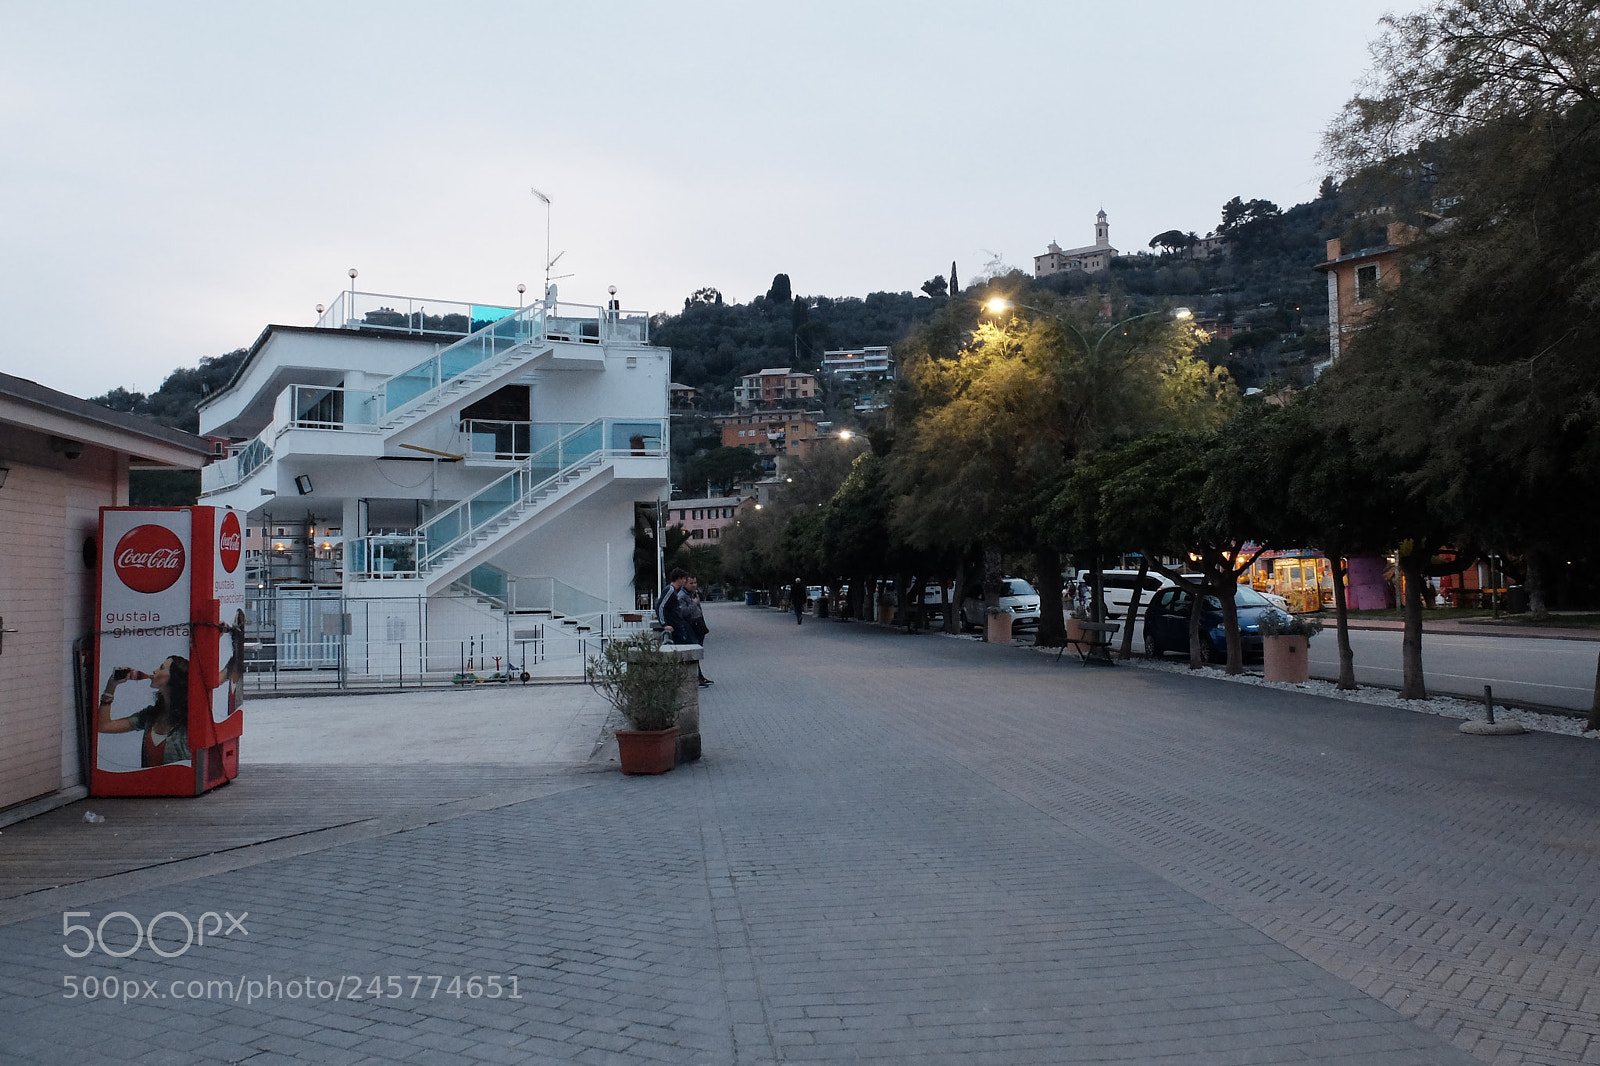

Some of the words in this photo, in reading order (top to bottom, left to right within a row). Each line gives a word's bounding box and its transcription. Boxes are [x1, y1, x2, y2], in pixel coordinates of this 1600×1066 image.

[118, 549, 182, 568] Coca-Cola
[215, 579, 235, 592] gustala
[106, 611, 160, 624] gustala
[113, 625, 190, 638] ghiacciata
